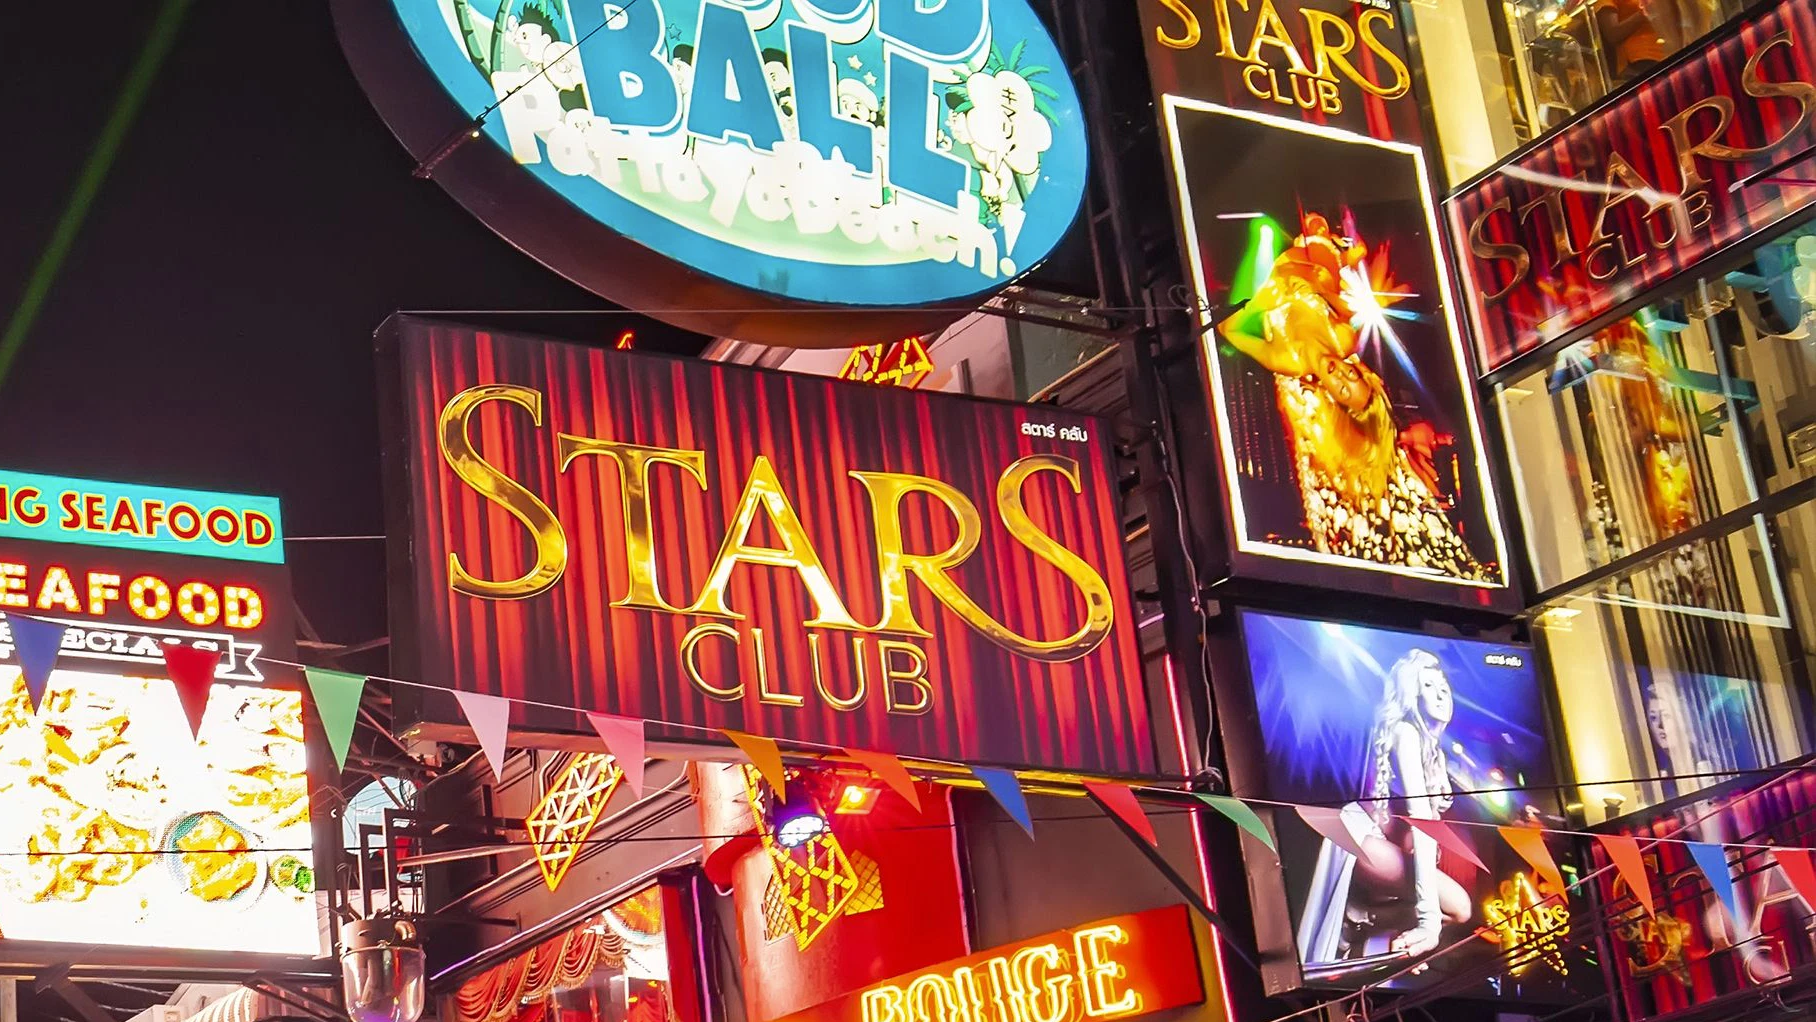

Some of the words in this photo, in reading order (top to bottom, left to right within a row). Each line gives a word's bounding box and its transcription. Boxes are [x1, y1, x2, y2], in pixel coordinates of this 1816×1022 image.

[1156, 0, 1410, 100] STARS
[1243, 66, 1342, 115] CLUB
[568, 0, 972, 212] BALL
[1470, 30, 1816, 298] STARS
[61, 491, 274, 548] SEAFOOD
[439, 383, 1114, 664] STARS
[679, 623, 934, 715] CLUB
